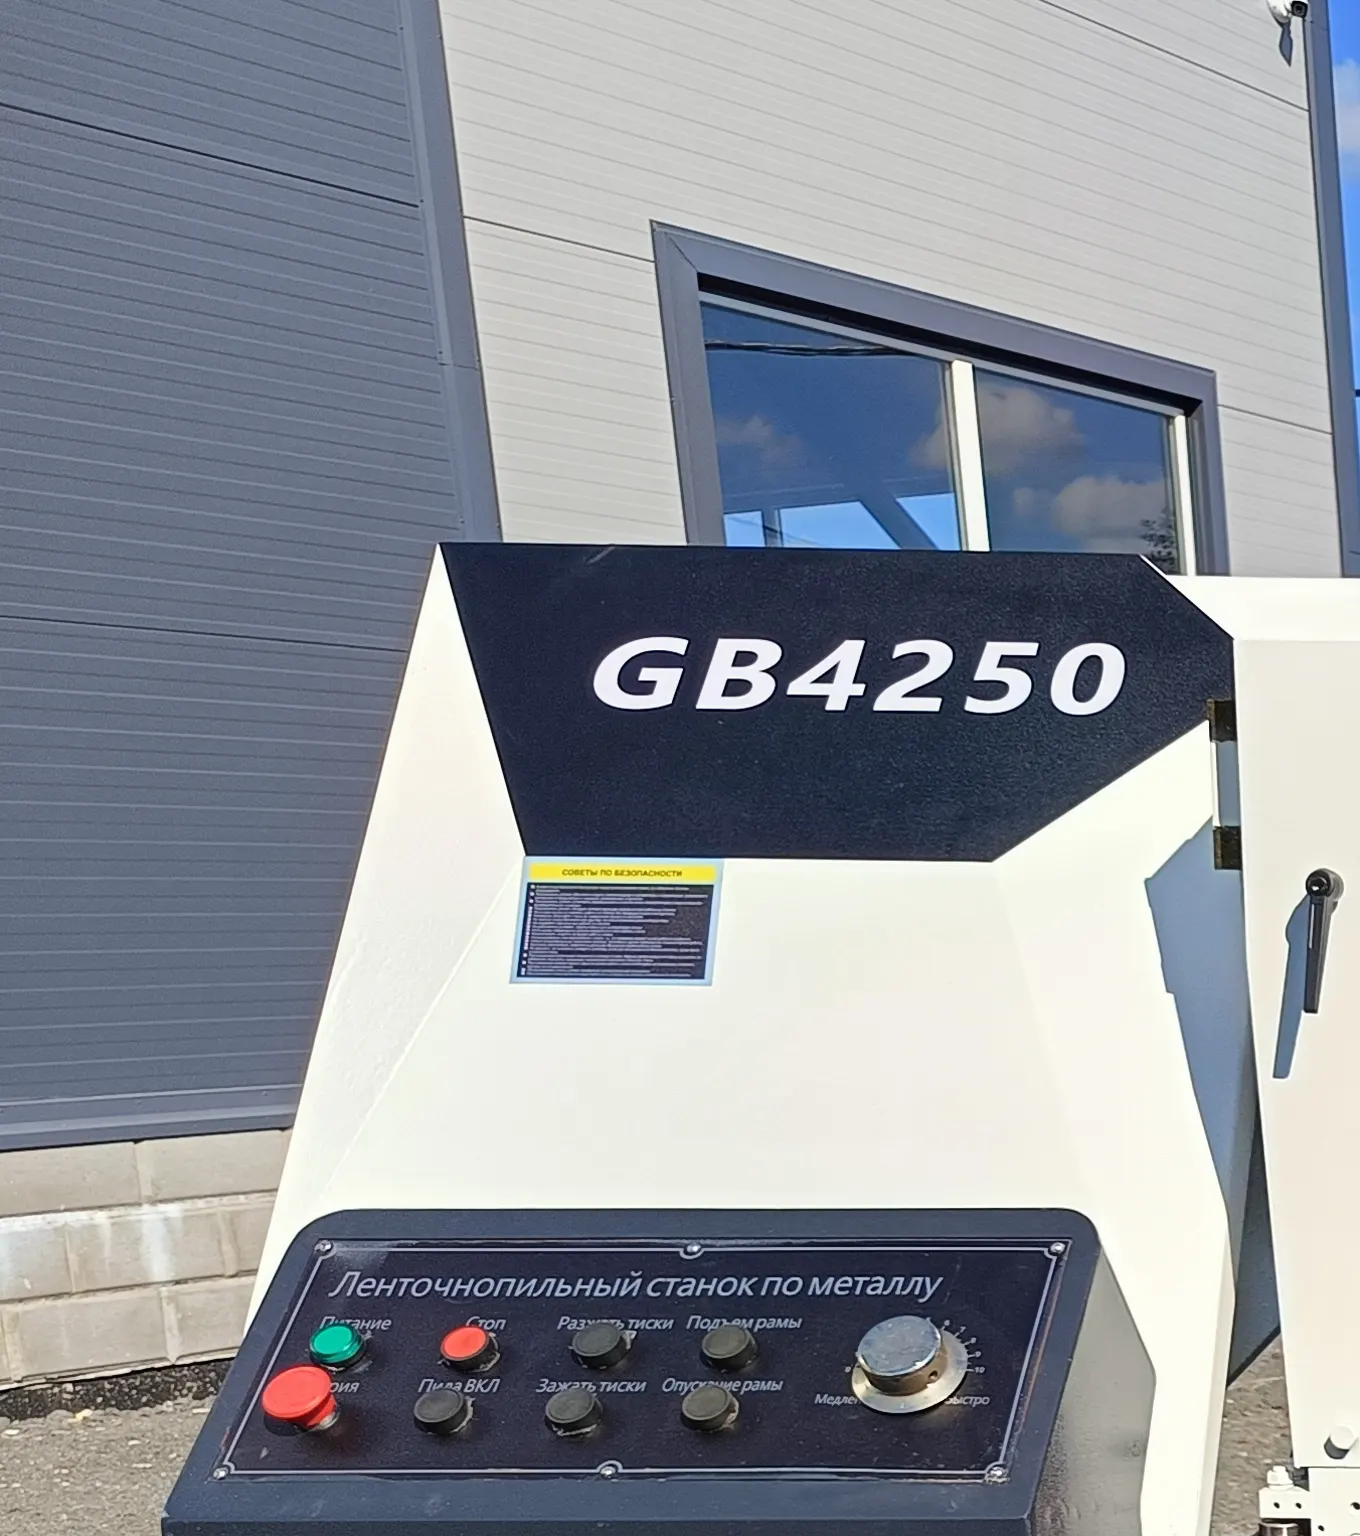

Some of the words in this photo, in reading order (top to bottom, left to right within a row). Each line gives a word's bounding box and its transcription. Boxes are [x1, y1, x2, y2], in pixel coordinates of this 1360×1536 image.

[593, 636, 1126, 716] GB4250
[561, 868, 598, 877] СОВЕТЫ
[600, 868, 613, 877] ПО
[614, 868, 684, 878] БЕЗОПАСНОСТИ
[327, 1270, 643, 1298] Ленточнопильный
[645, 1276, 759, 1297] станок
[760, 1276, 804, 1297] по
[807, 1276, 943, 1303] металлу
[627, 1318, 675, 1331] тиски
[752, 1317, 803, 1333] рамы
[463, 1378, 501, 1393] ВКЛ
[599, 1381, 648, 1393] тиски
[739, 1380, 784, 1396] рамы
